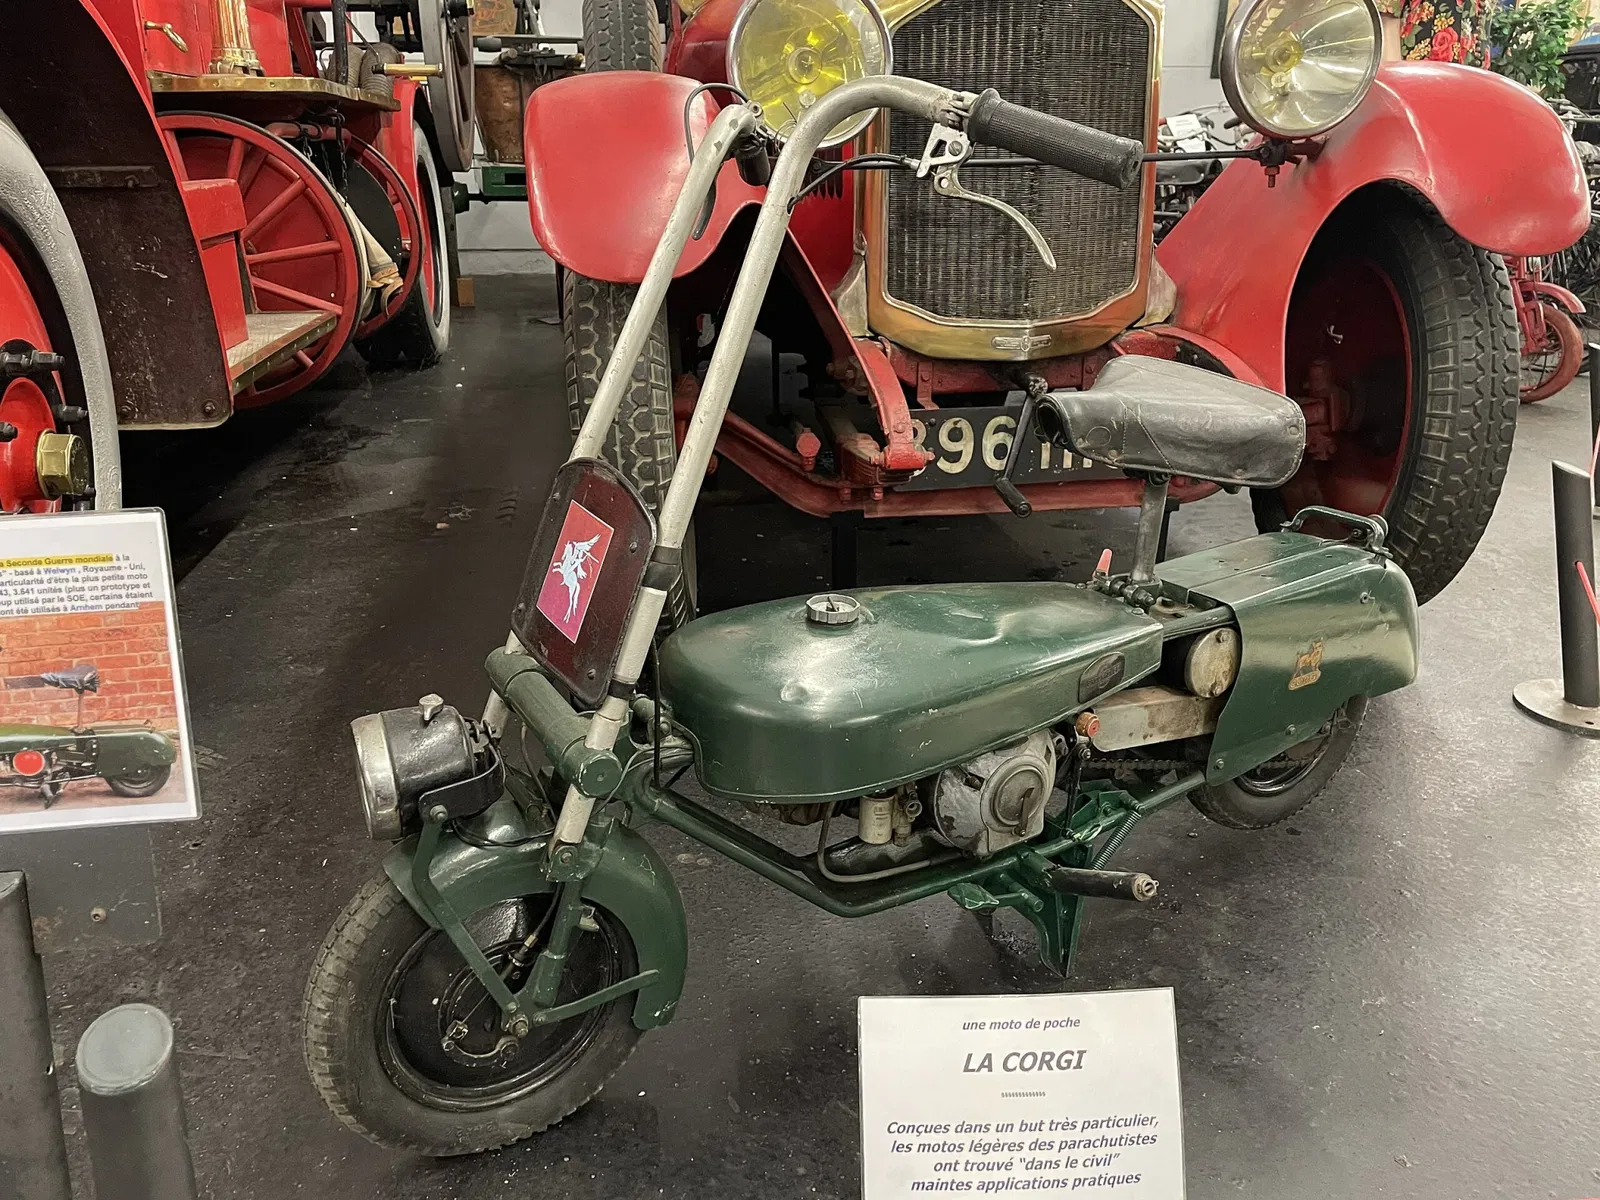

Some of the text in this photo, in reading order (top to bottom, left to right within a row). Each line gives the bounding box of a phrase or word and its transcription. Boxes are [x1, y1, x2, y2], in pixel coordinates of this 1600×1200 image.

[6, 558, 42, 568] Seconde
[44, 557, 73, 566] Guerre
[75, 555, 113, 564] mondiale
[14, 567, 34, 577] basé
[36, 568, 42, 576] à
[43, 567, 76, 575] Welwyn
[82, 565, 122, 574] Royaume
[129, 563, 146, 571] Uni,
[0, 578, 44, 587] articularité
[47, 577, 70, 585] d'être
[81, 575, 99, 584] plus
[101, 574, 125, 583] petite
[37, 586, 63, 595] unités
[65, 585, 85, 595] (plus
[101, 583, 140, 592] prototype
[14, 596, 39, 605] utilisé
[42, 597, 56, 605] par
[57, 595, 65, 603] le
[66, 594, 88, 603] SOE,
[90, 592, 123, 601] certains
[125, 591, 153, 599] étaient
[16, 607, 29, 615] été
[31, 605, 61, 614] utilisés
[63, 604, 68, 612] à
[105, 602, 139, 611] pendant
[962, 1017, 1081, 1031] une moto de poche
[963, 1050, 1087, 1073] LA CORGI
[887, 1114, 1159, 1137] Conçues dans un but très particulier,
[891, 1133, 1158, 1155] les motos légères des parachutistes
[933, 1159, 960, 1172] ont
[964, 1157, 1014, 1172] trouvé
[1065, 1156, 1078, 1169] le
[911, 1173, 1142, 1193] maintes applications pratiques
